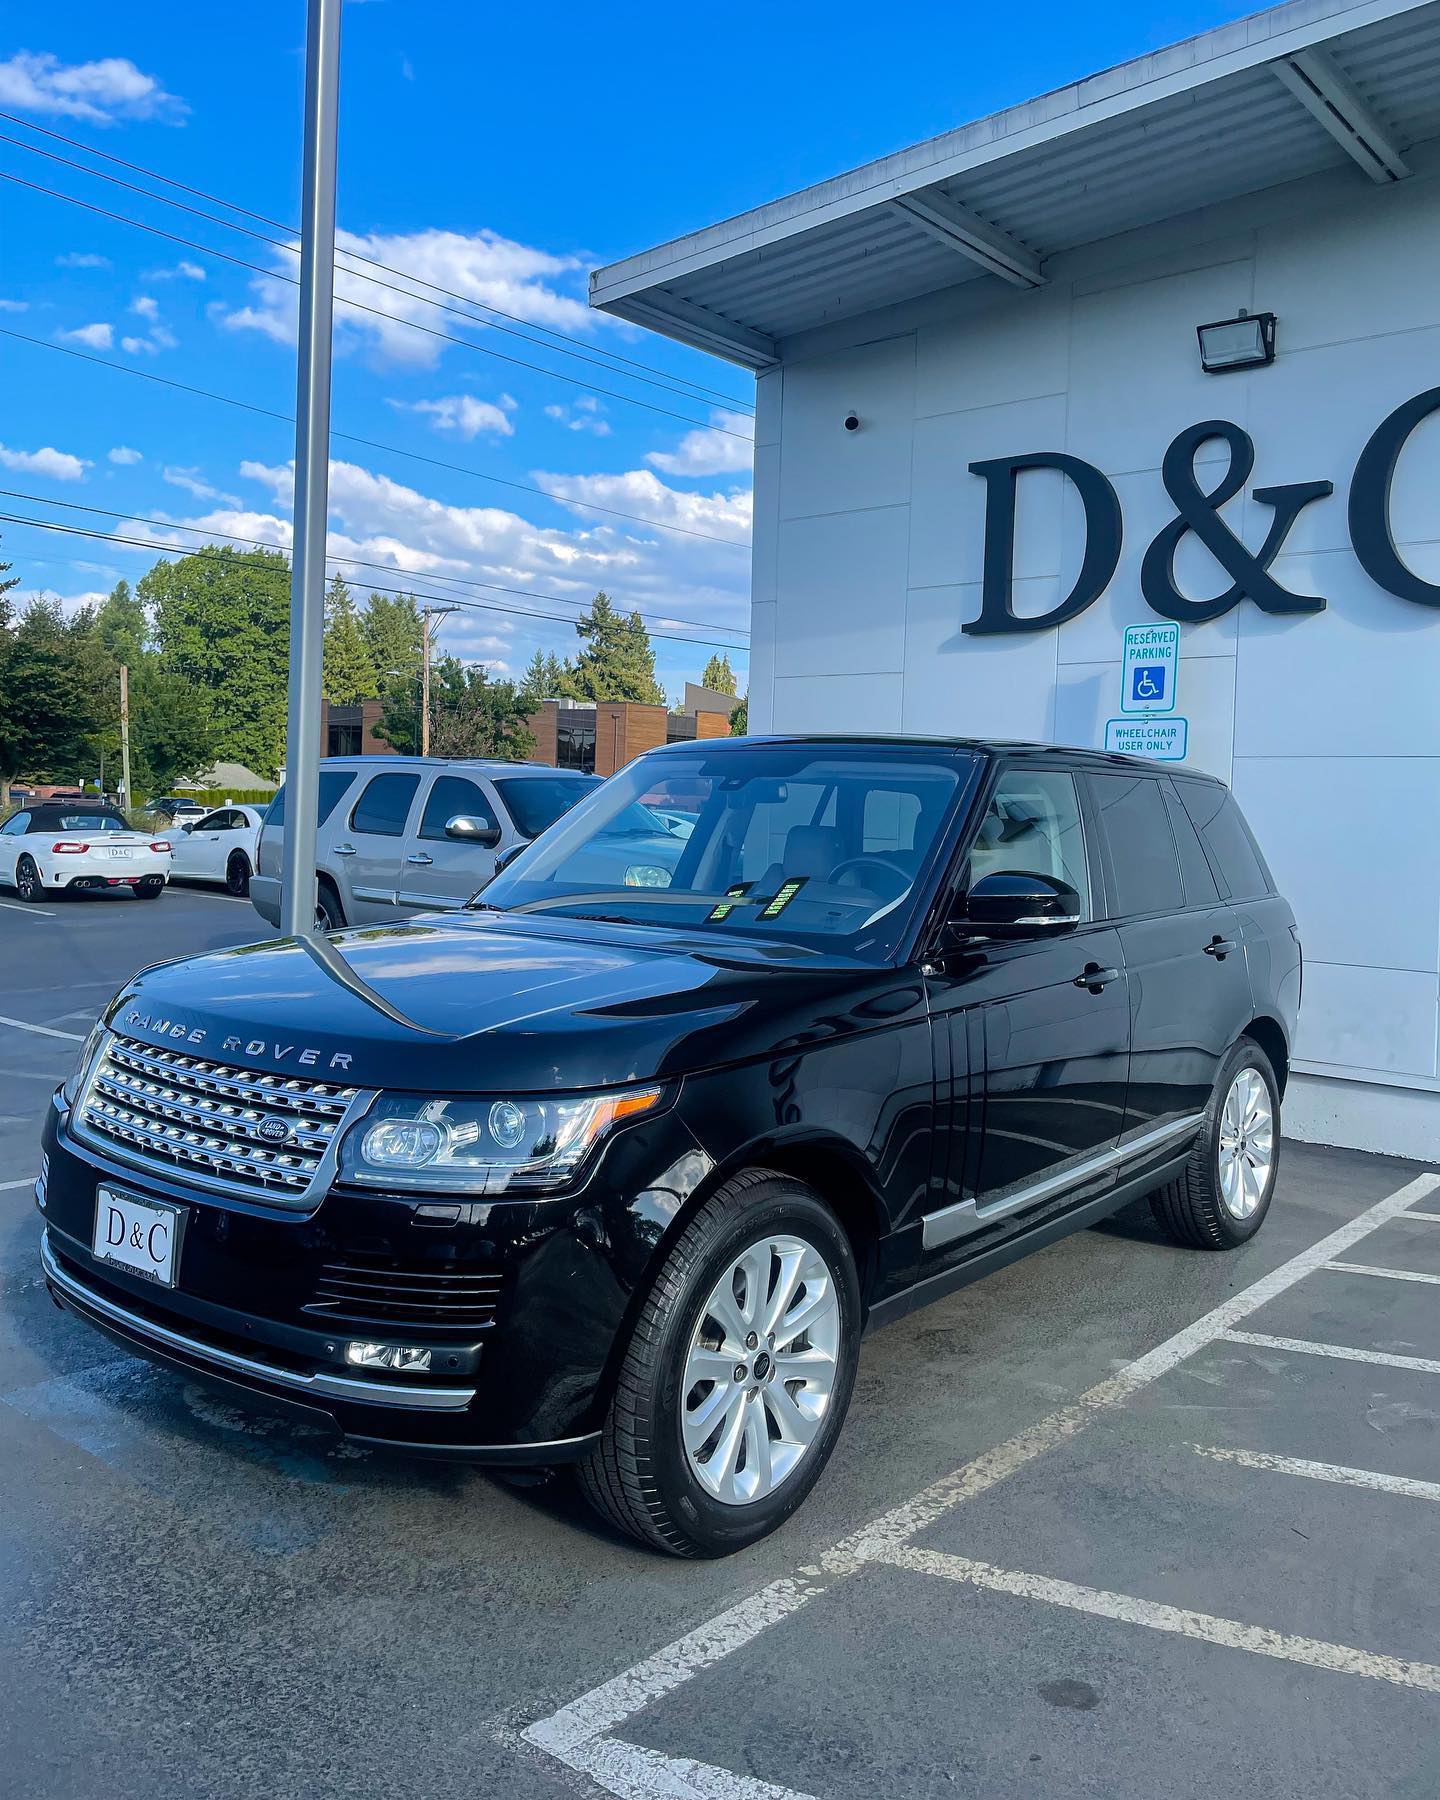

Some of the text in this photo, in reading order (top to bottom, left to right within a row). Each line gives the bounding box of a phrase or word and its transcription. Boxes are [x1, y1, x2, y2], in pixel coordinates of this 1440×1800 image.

[1127, 631, 1175, 645] RESERVED
[1129, 646, 1172, 660] PARKING
[1115, 728, 1177, 738] WHEELCHAIR
[1118, 741, 1173, 751] USER ONLY
[125, 1010, 353, 1070] RANGE ROVER
[265, 1122, 282, 1130] LAND
[264, 1128, 284, 1137] ROVER
[105, 1206, 167, 1263] D&C
